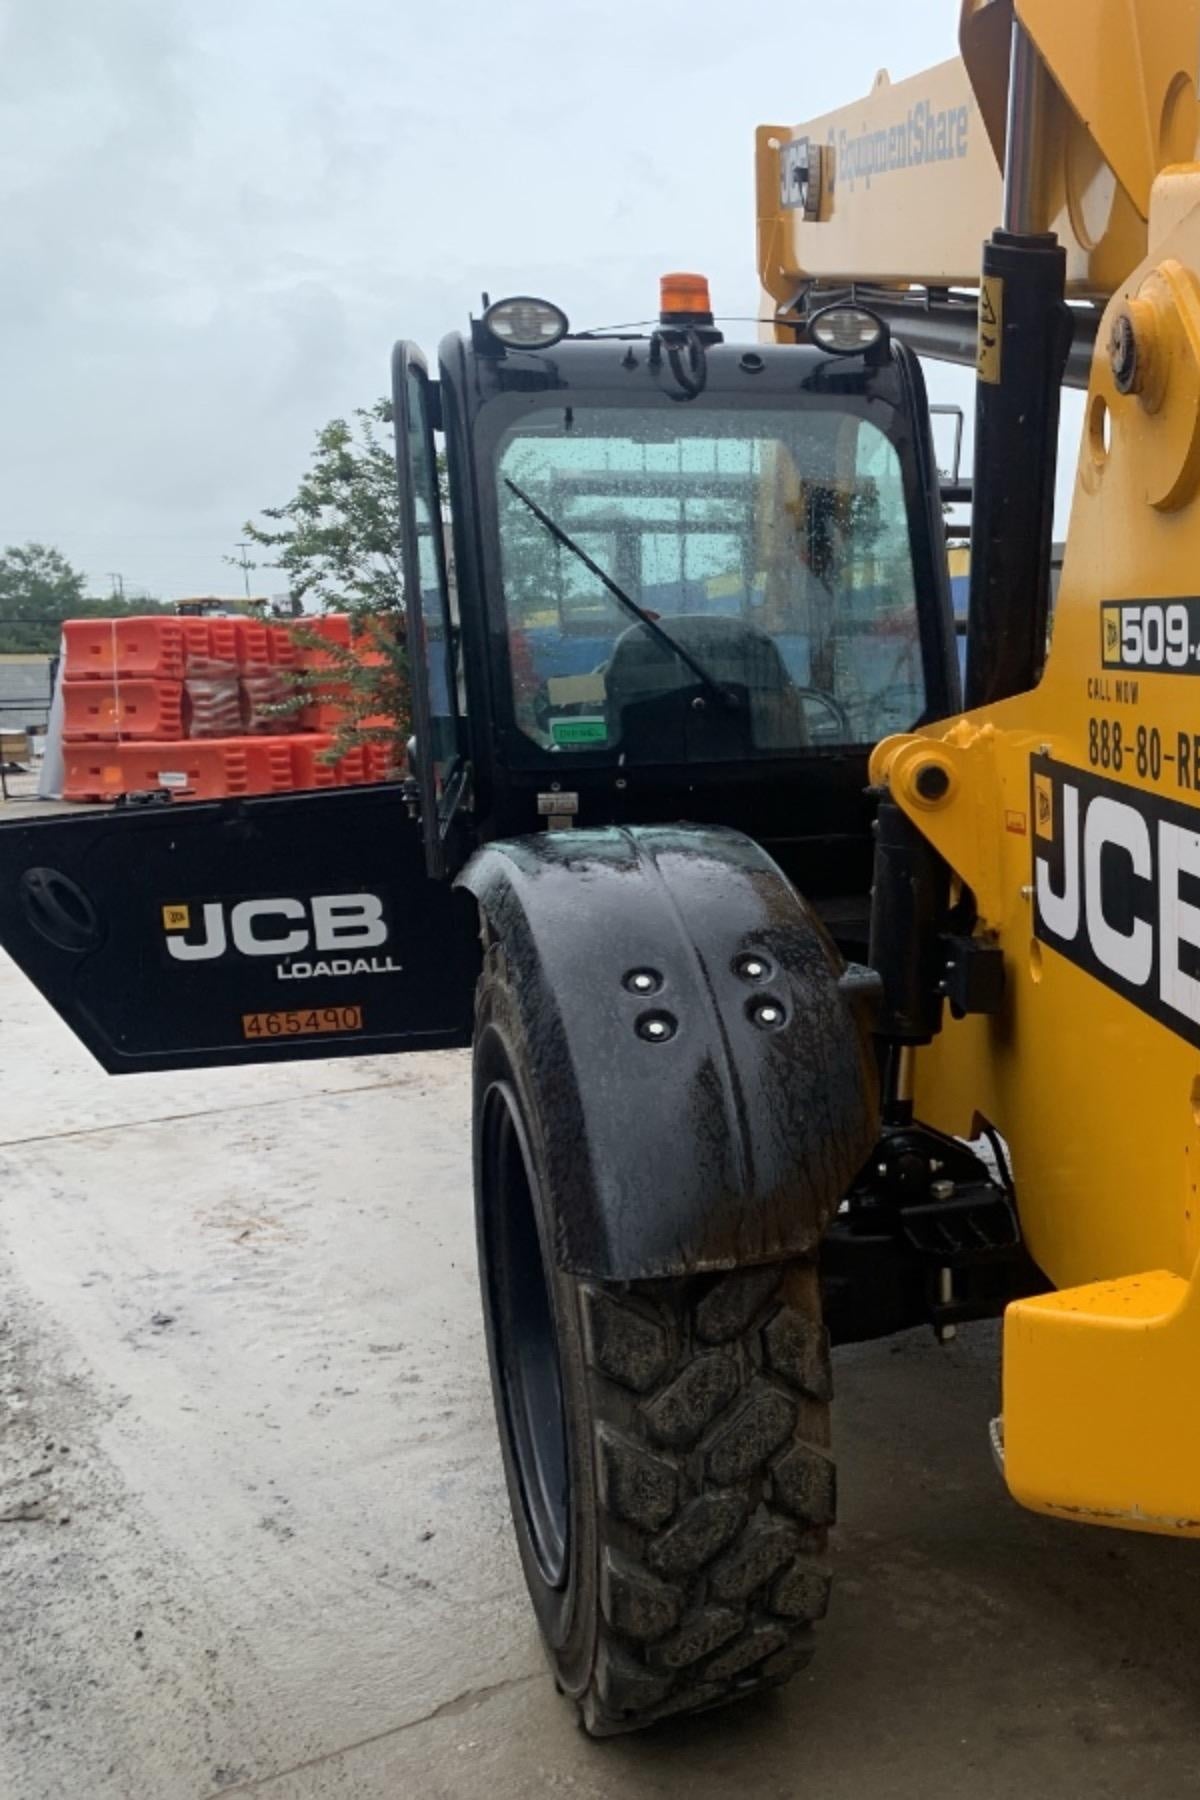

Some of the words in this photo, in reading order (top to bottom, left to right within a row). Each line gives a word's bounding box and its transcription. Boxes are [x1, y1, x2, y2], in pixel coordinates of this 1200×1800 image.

[839, 99, 969, 193] EquipmentShare
[1087, 677, 1111, 702] CALL
[1115, 681, 1139, 705] NOW
[165, 893, 388, 961] JCB
[277, 956, 402, 980] LOADALL
[246, 1007, 360, 1036] 465490
